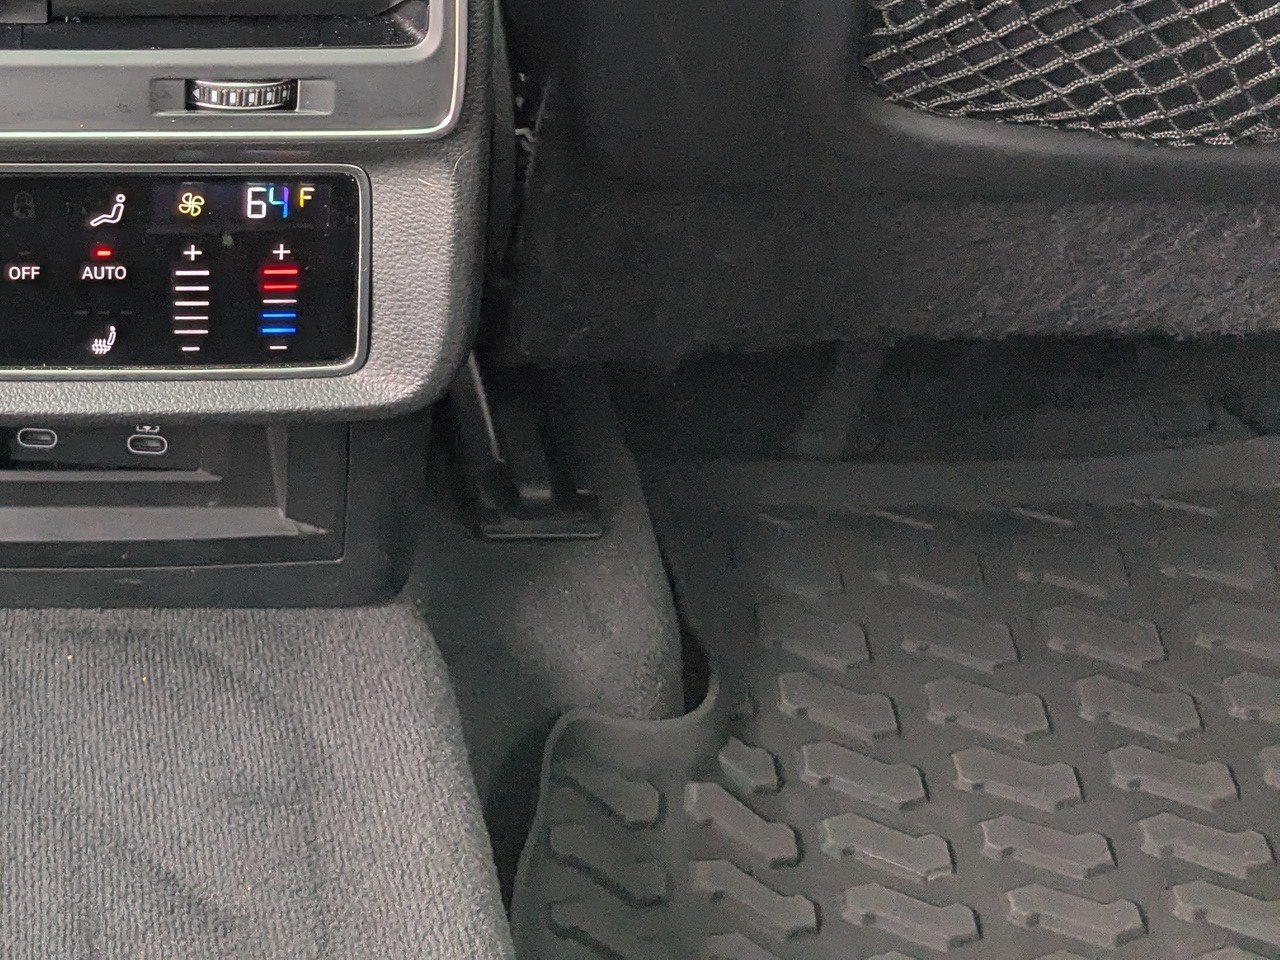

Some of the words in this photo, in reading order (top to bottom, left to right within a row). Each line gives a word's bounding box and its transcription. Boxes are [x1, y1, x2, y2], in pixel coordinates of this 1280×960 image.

[246, 186, 289, 218] 64
[299, 186, 315, 208] F
[8, 266, 41, 280] OFF
[81, 266, 127, 280] AUTO
